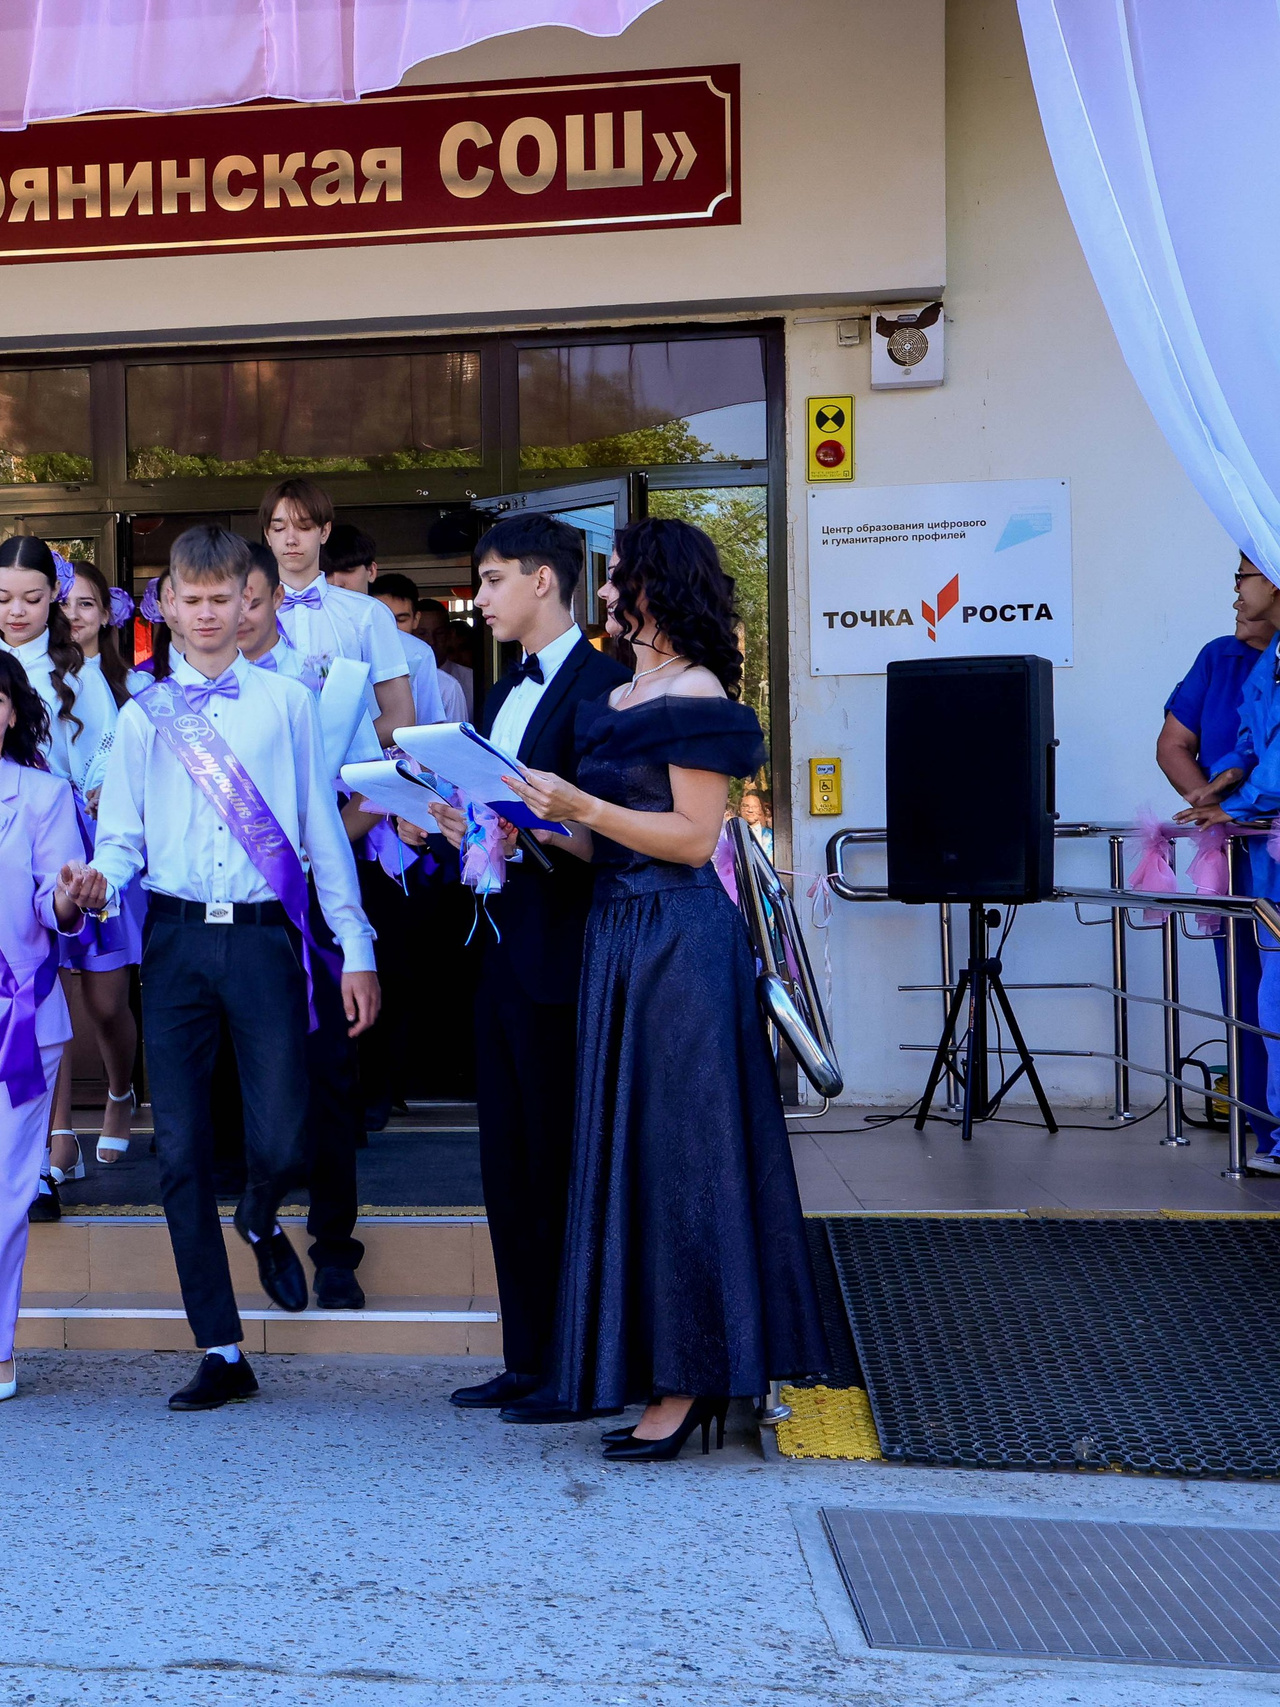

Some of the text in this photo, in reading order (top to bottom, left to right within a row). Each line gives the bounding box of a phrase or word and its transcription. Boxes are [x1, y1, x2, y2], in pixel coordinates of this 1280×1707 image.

[438, 109, 699, 202] СОШ»
[822, 518, 987, 535] Центр образования цифрового
[831, 535, 909, 547] гуманитарного
[911, 531, 966, 542] профилей
[823, 603, 1053, 629] ТОЧКА РОСТА
[173, 713, 252, 821] Выпускник
